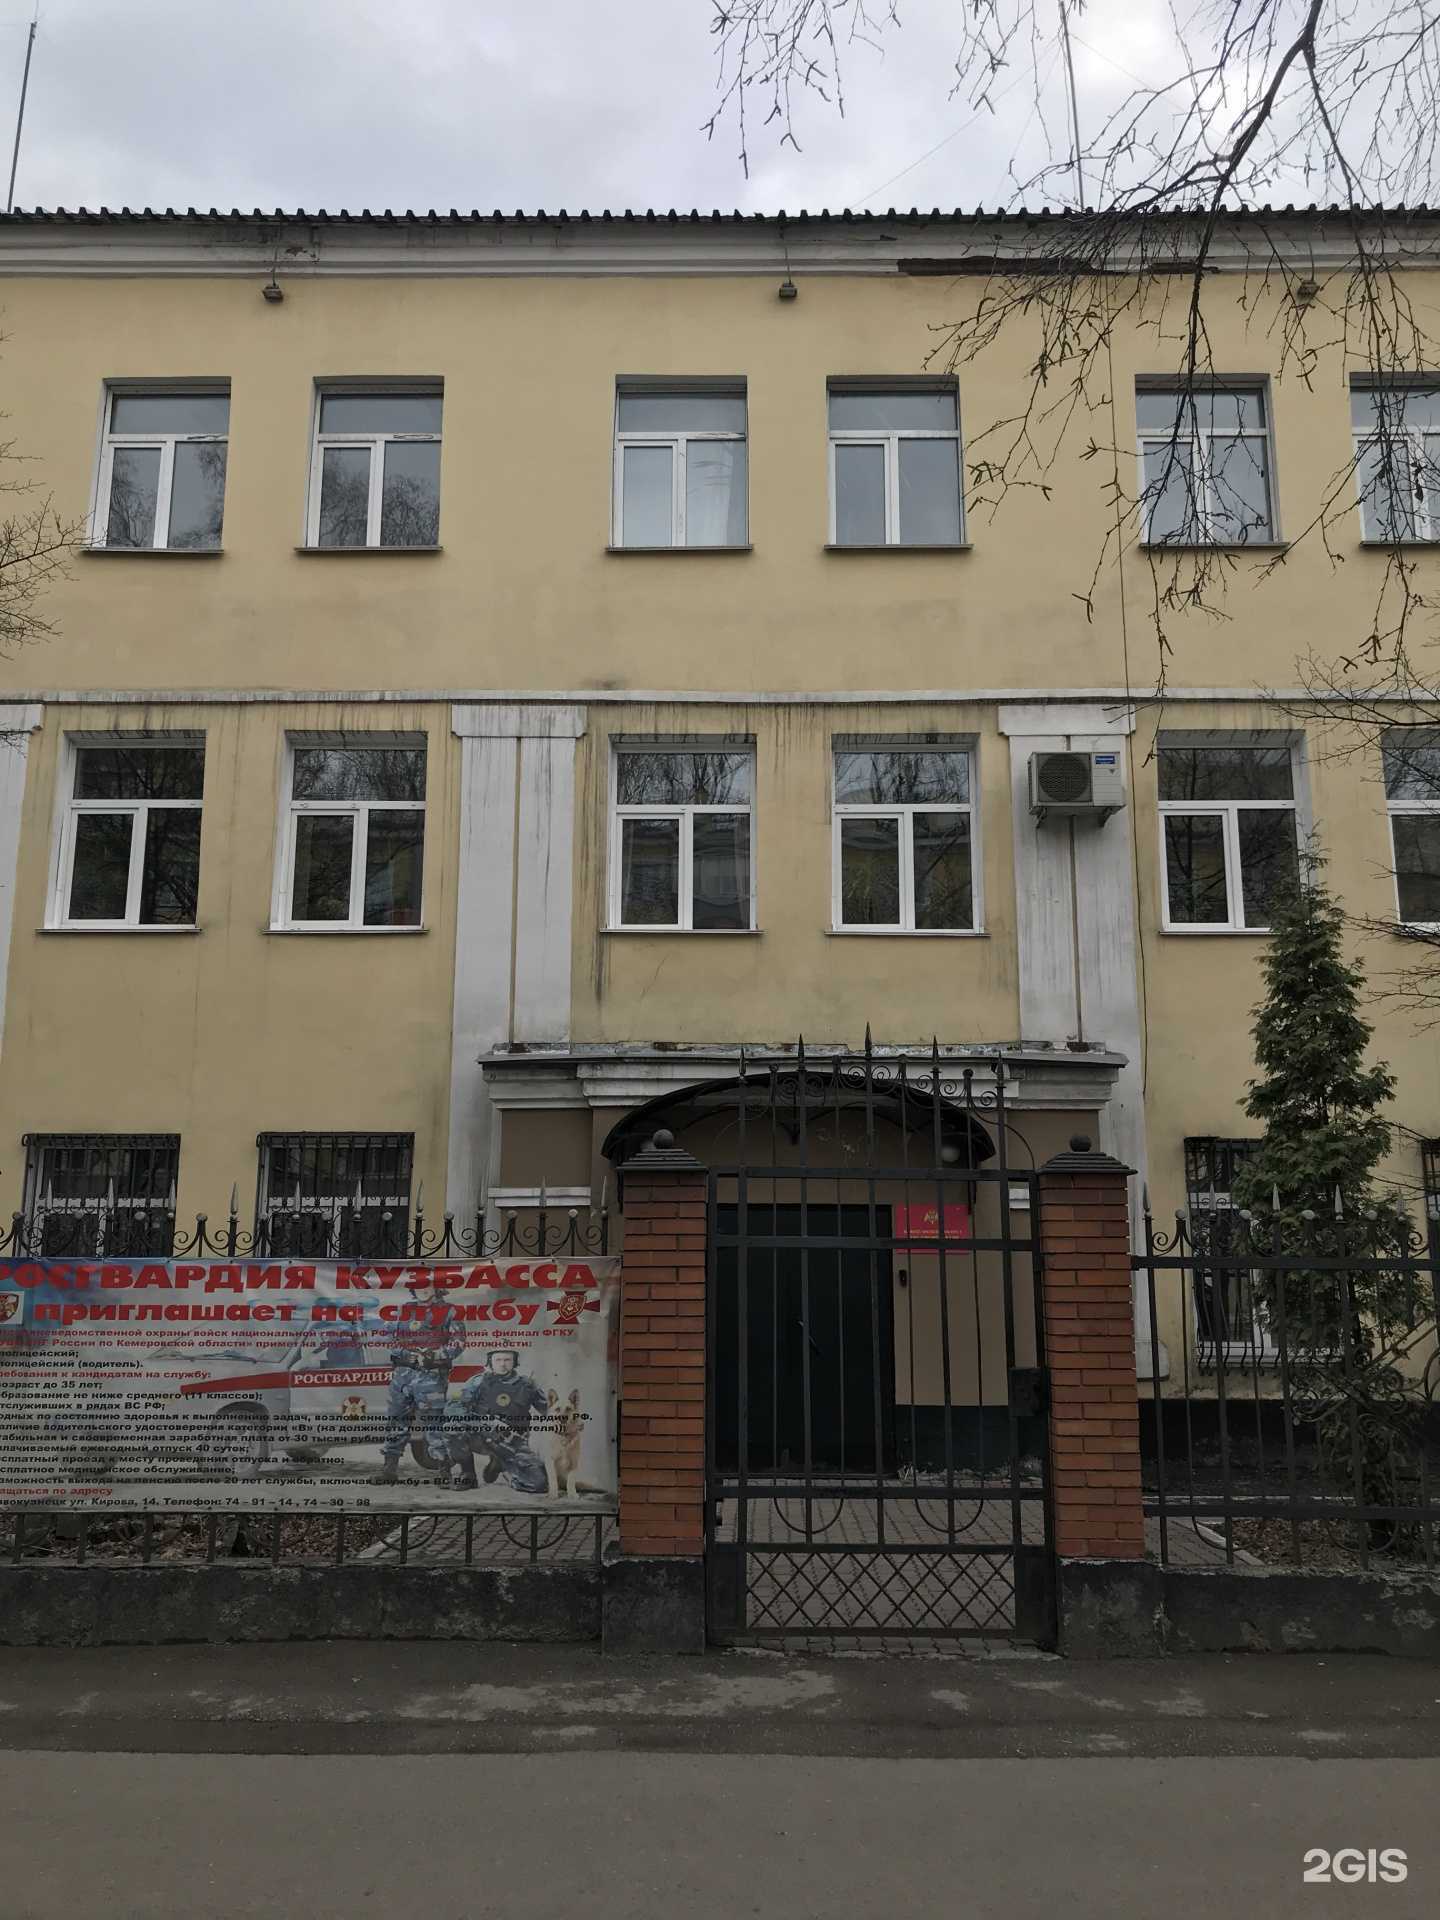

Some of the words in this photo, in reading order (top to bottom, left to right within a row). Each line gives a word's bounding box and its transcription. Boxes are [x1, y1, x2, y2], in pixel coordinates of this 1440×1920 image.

[336, 1264, 598, 1290] КУЗБАССА
[34, 1304, 297, 1325] приглашает
[312, 1305, 362, 1322] на
[379, 1297, 540, 1325] службу
[146, 1330, 190, 1338] охраны
[194, 1329, 228, 1337] войск
[231, 1329, 317, 1338] национальной
[492, 1328, 539, 1337] филиал
[52, 1338, 96, 1347] России
[117, 1339, 194, 1349] Кемеровской
[463, 1338, 532, 1349] должности:
[72, 1371, 142, 1380] кандидатам
[293, 1370, 394, 1385] РОСГВАРДИЯ
[0, 1381, 40, 1391] озраст
[43, 1382, 58, 1390] до
[61, 1380, 76, 1389] 35
[0, 1390, 70, 1400] бразование
[126, 1392, 182, 1400] среднего
[0, 1402, 73, 1411] тслуживших
[86, 1403, 120, 1411] рядах
[124, 1401, 141, 1409] ВС
[0, 1413, 33, 1422] одных
[124, 1413, 179, 1422] здоровья
[192, 1413, 269, 1421] выполнению
[314, 1413, 398, 1422] возложенных
[43, 1424, 132, 1432] водительского
[135, 1424, 224, 1433] удостоверения
[227, 1424, 288, 1433] категории
[316, 1423, 336, 1433] (на
[339, 1424, 404, 1433] должность
[0, 1433, 57, 1441] табильная
[169, 1433, 238, 1443] заработная
[294, 1434, 308, 1442] 30
[0, 1443, 77, 1452] плачиваемый
[80, 1444, 149, 1453] ежегодный
[152, 1445, 192, 1453] отпуск
[195, 1444, 210, 1453] 40
[1, 1454, 58, 1463] сплатный
[62, 1455, 106, 1464] проезд
[119, 1456, 155, 1464] месту
[157, 1455, 229, 1464] проведения
[231, 1456, 279, 1464] отпуска
[1, 1466, 55, 1474] сплатное
[58, 1466, 140, 1474] медицинское
[0, 1477, 64, 1485] зможность
[67, 1477, 113, 1486] выхода
[224, 1476, 239, 1485] 20
[241, 1477, 262, 1485] лет
[70, 1488, 113, 1497] адресу
[69, 1499, 87, 1508] ул.
[91, 1497, 138, 1508] Кирова,
[164, 1497, 222, 1508] Телефон:
[225, 1497, 240, 1506] 74
[251, 1497, 266, 1506] 91
[279, 1497, 293, 1506] 14
[303, 1497, 318, 1506] 74
[329, 1497, 344, 1507] 30
[356, 1498, 371, 1507] 98
